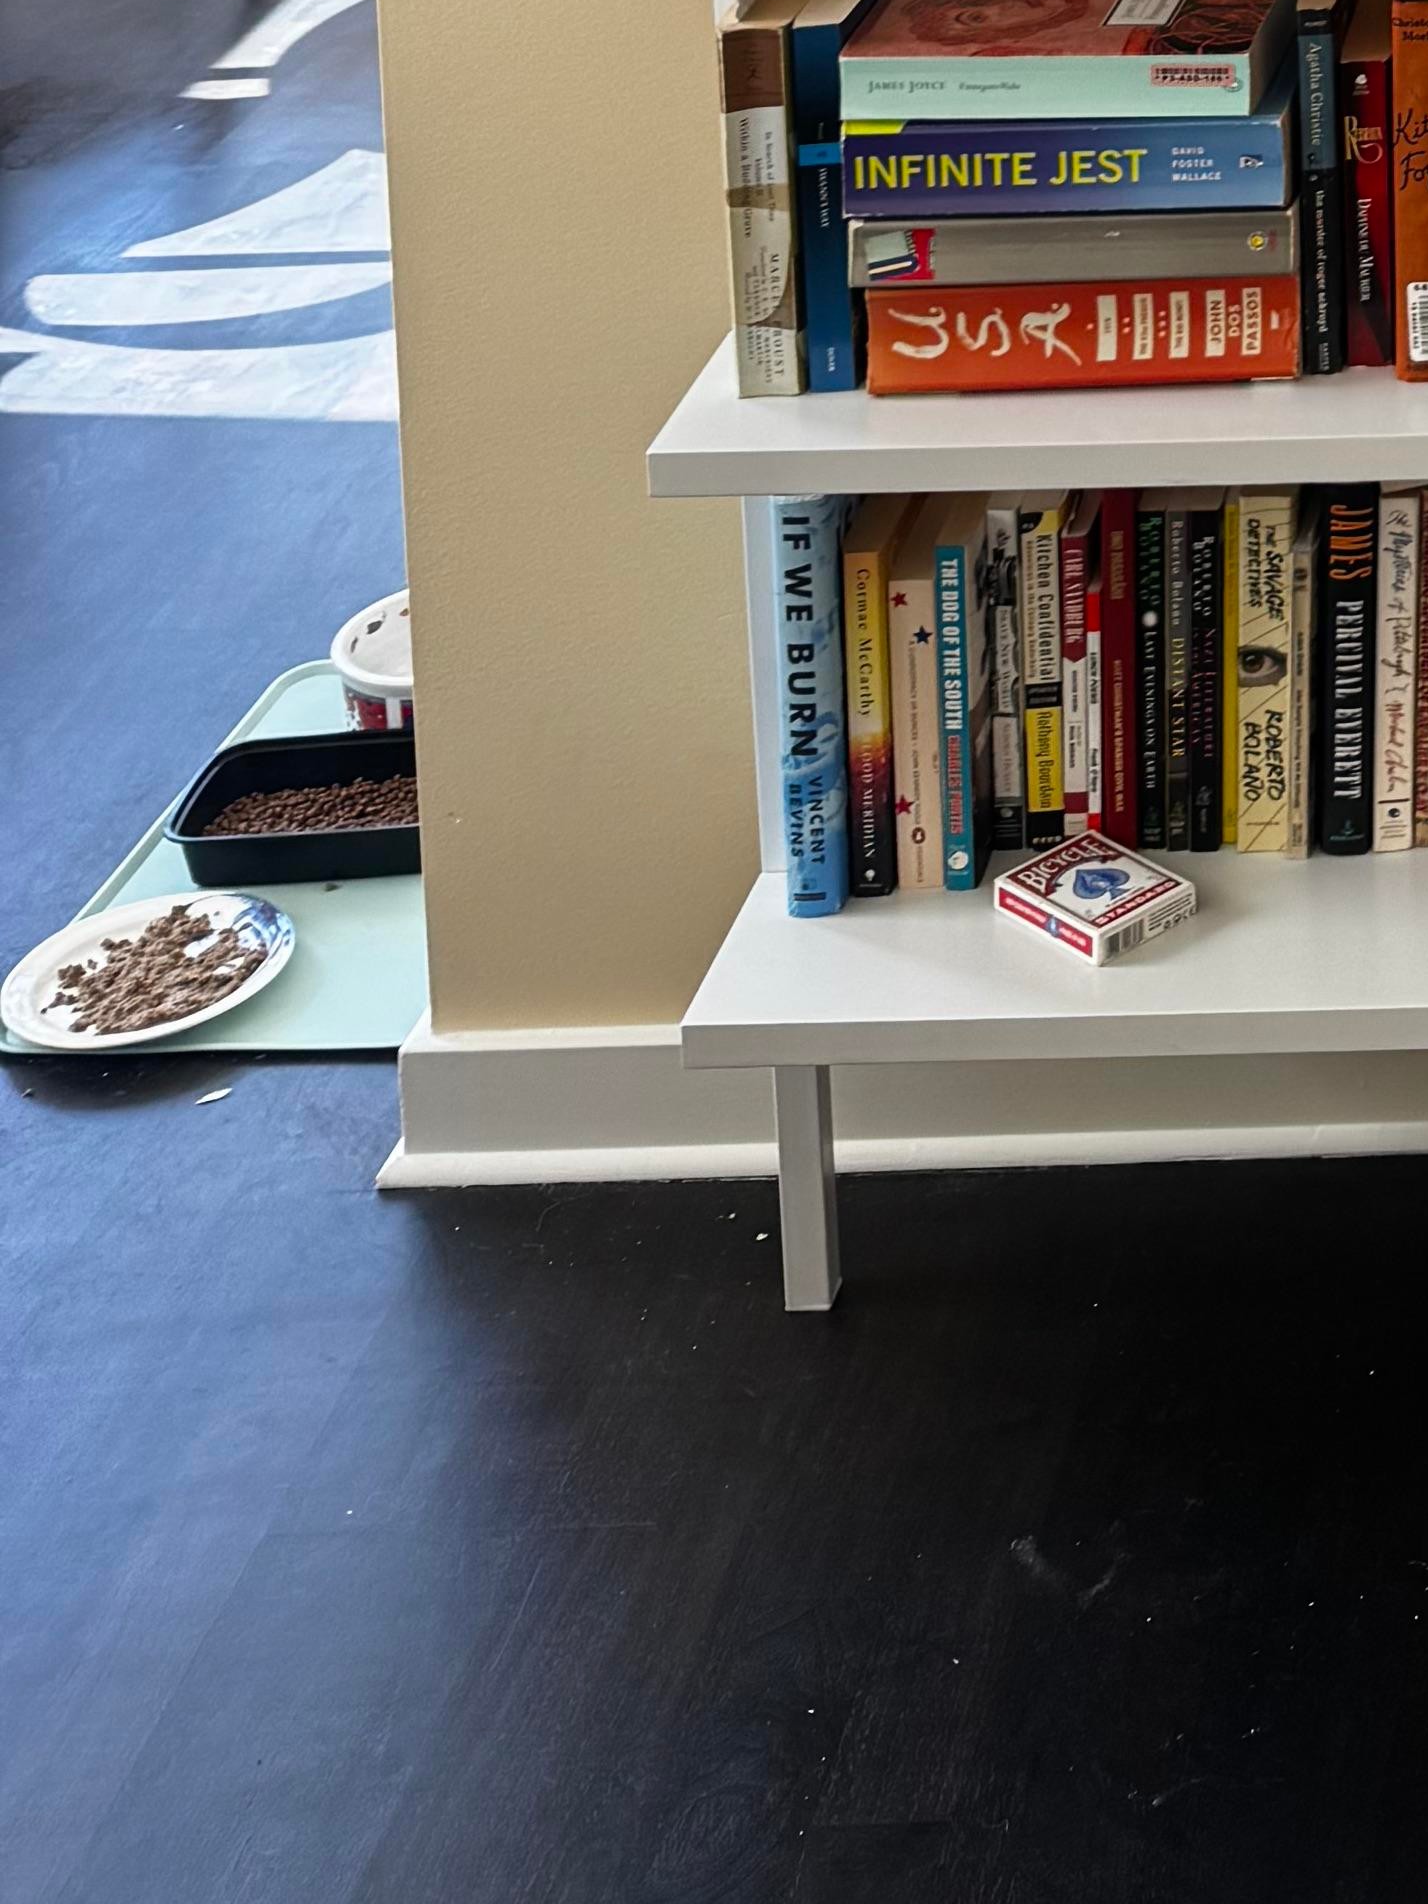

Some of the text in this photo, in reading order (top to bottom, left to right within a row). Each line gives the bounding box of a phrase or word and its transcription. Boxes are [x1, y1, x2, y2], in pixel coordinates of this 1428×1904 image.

[854, 150, 1148, 190] INFINITE JEST
[1209, 300, 1223, 343] JOHN
[1228, 303, 1241, 337] DOS
[1245, 289, 1259, 351] PASSOS
[781, 516, 818, 759] IF WE BURN
[1329, 503, 1373, 800] JAMES PERCIVAL EVERETT
[1017, 838, 1110, 893] BICYCLE
